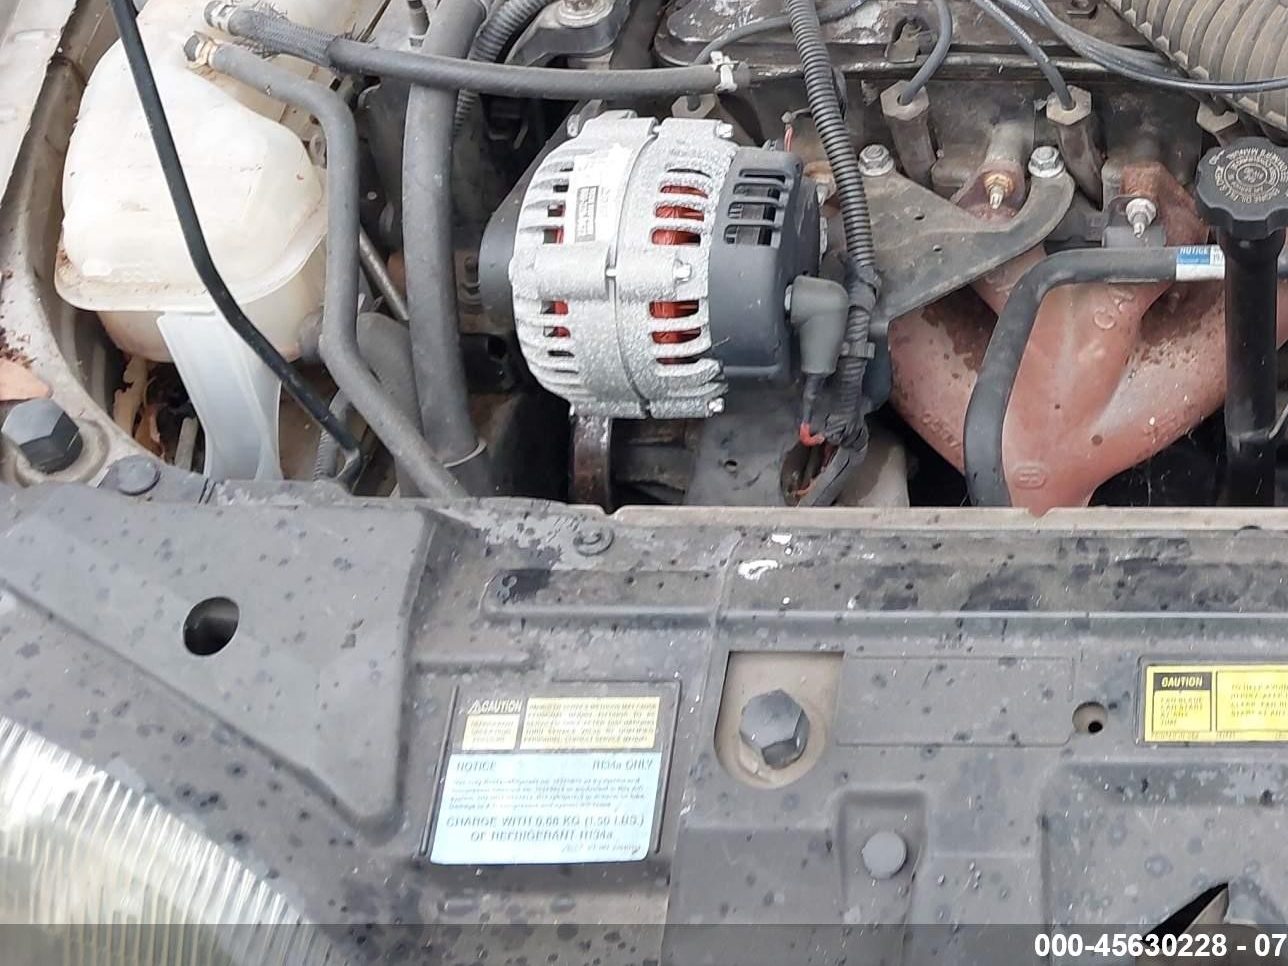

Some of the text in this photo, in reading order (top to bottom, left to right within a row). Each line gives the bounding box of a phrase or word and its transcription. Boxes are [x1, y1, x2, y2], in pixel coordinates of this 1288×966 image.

[1179, 247, 1209, 255] NOTICE
[1161, 676, 1203, 689] CAUTION
[481, 698, 522, 713] CAUTION
[456, 761, 497, 771] NOTICE
[625, 759, 654, 771] ONLY
[446, 817, 498, 827] CHARGE
[502, 816, 533, 827] WITH
